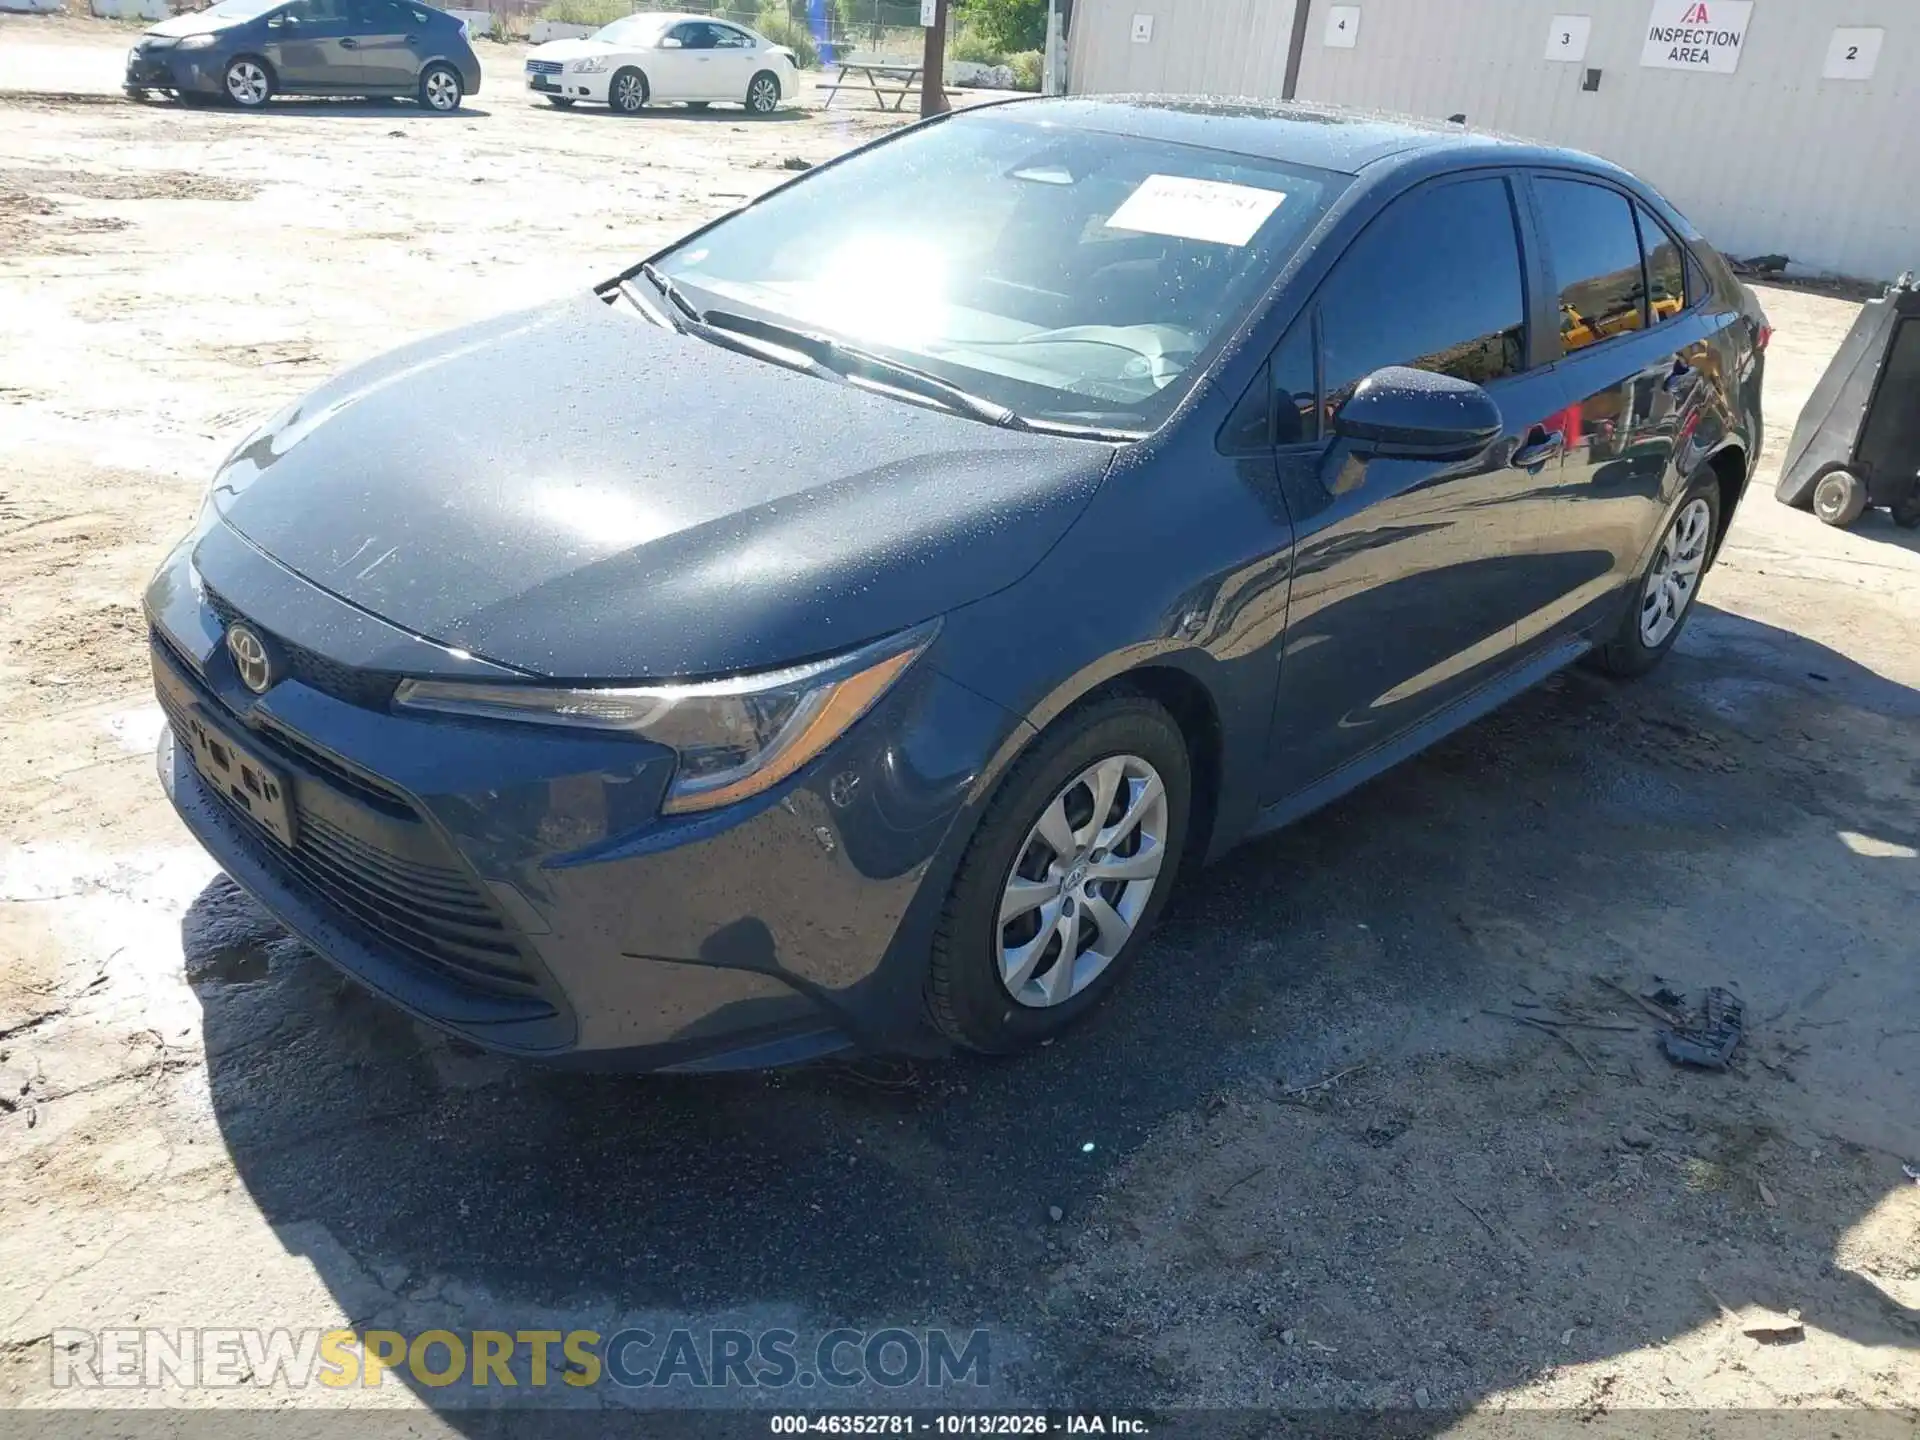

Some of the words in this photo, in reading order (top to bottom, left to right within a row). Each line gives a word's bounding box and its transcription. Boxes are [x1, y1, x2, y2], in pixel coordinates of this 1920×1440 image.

[1338, 19, 1345, 32] 4
[1561, 32, 1570, 45] 3
[1649, 26, 1740, 47] INSPECTION
[1668, 46, 1709, 63] AREA
[1845, 46, 1858, 60] 2
